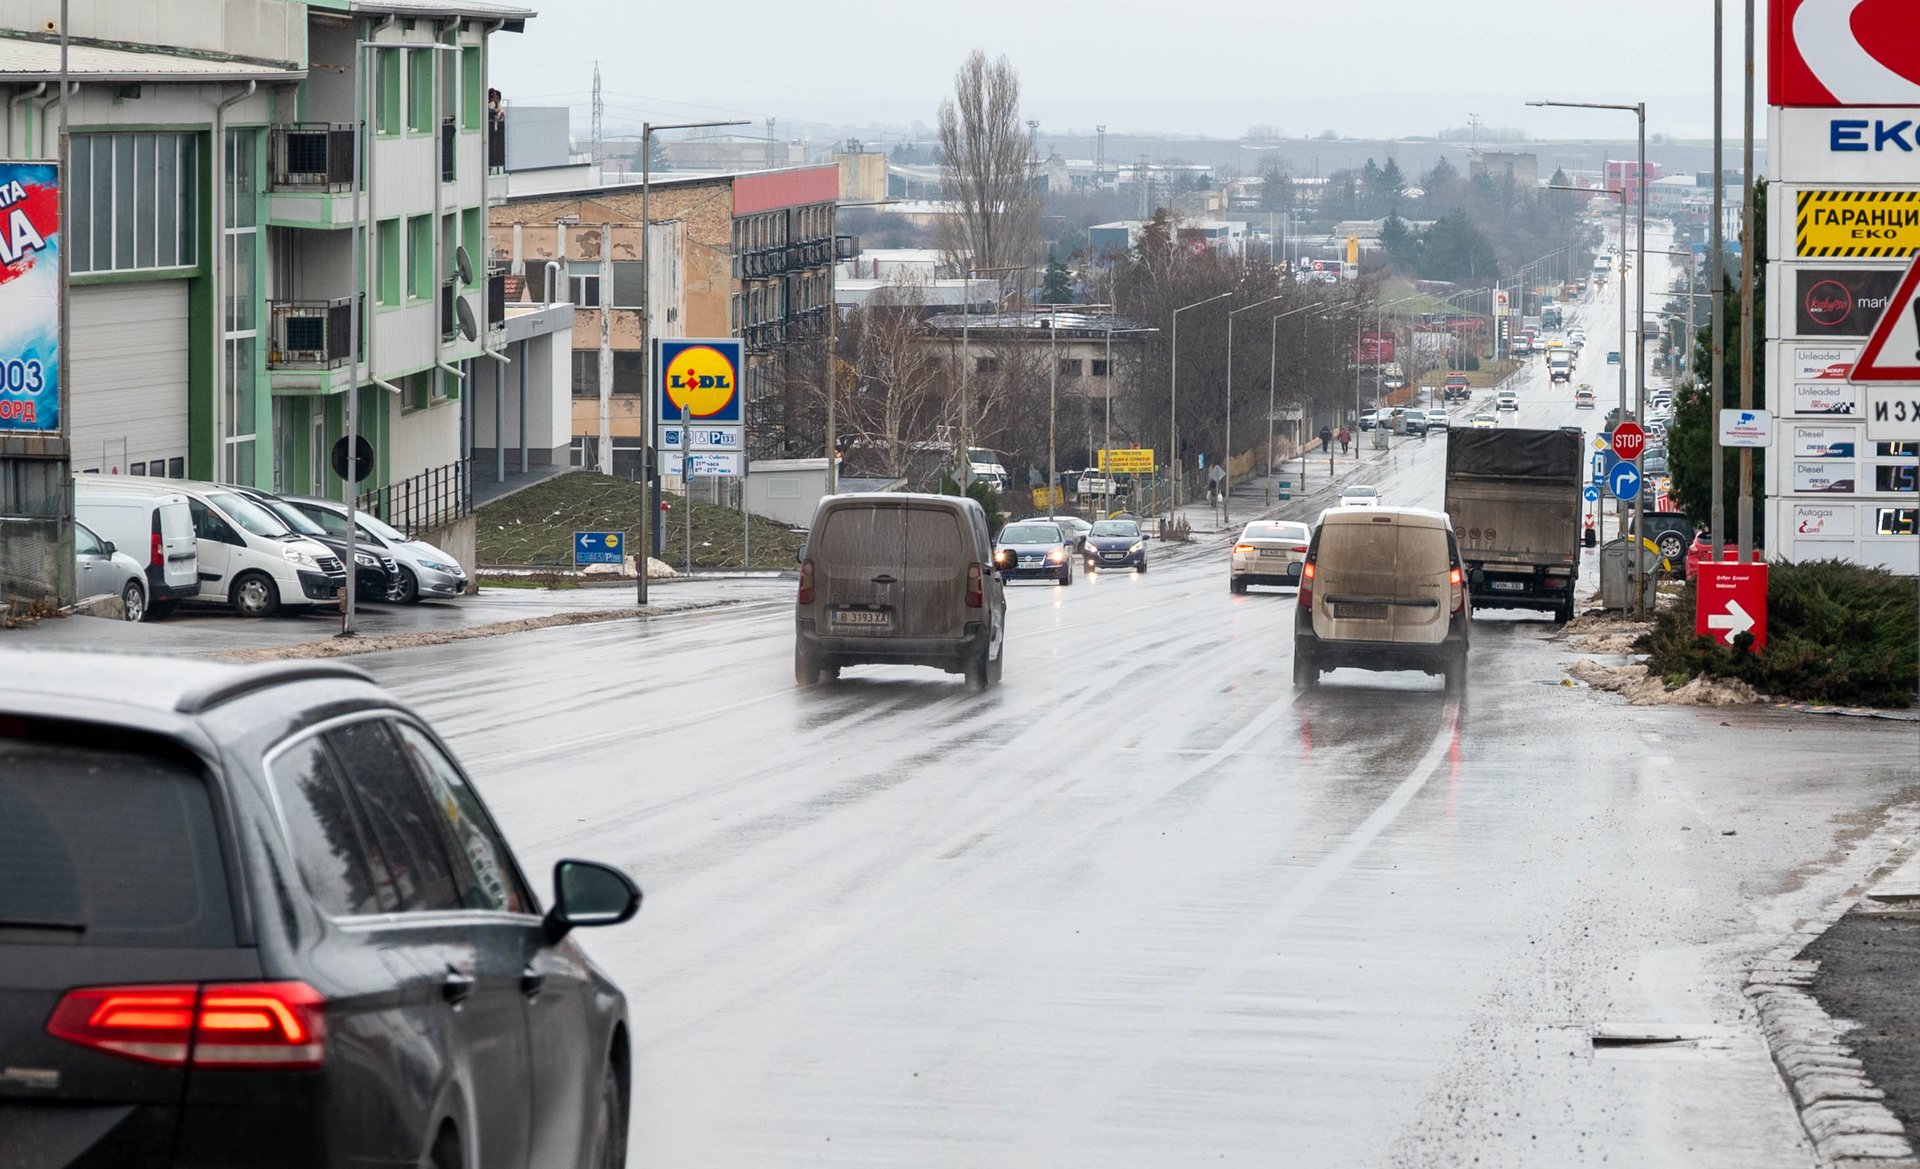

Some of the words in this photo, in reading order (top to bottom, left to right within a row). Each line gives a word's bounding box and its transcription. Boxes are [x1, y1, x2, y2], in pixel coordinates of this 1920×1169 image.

[1830, 119, 1920, 152] EK
[1798, 351, 1841, 361] Unleaded
[1798, 387, 1841, 396] Unleaded
[1798, 429, 1824, 438] Diesel
[721, 435, 735, 443] 133
[1615, 434, 1643, 448] STOP
[1797, 465, 1824, 473] Diesel
[1798, 508, 1834, 519] Autogas
[851, 612, 873, 622] 3193
